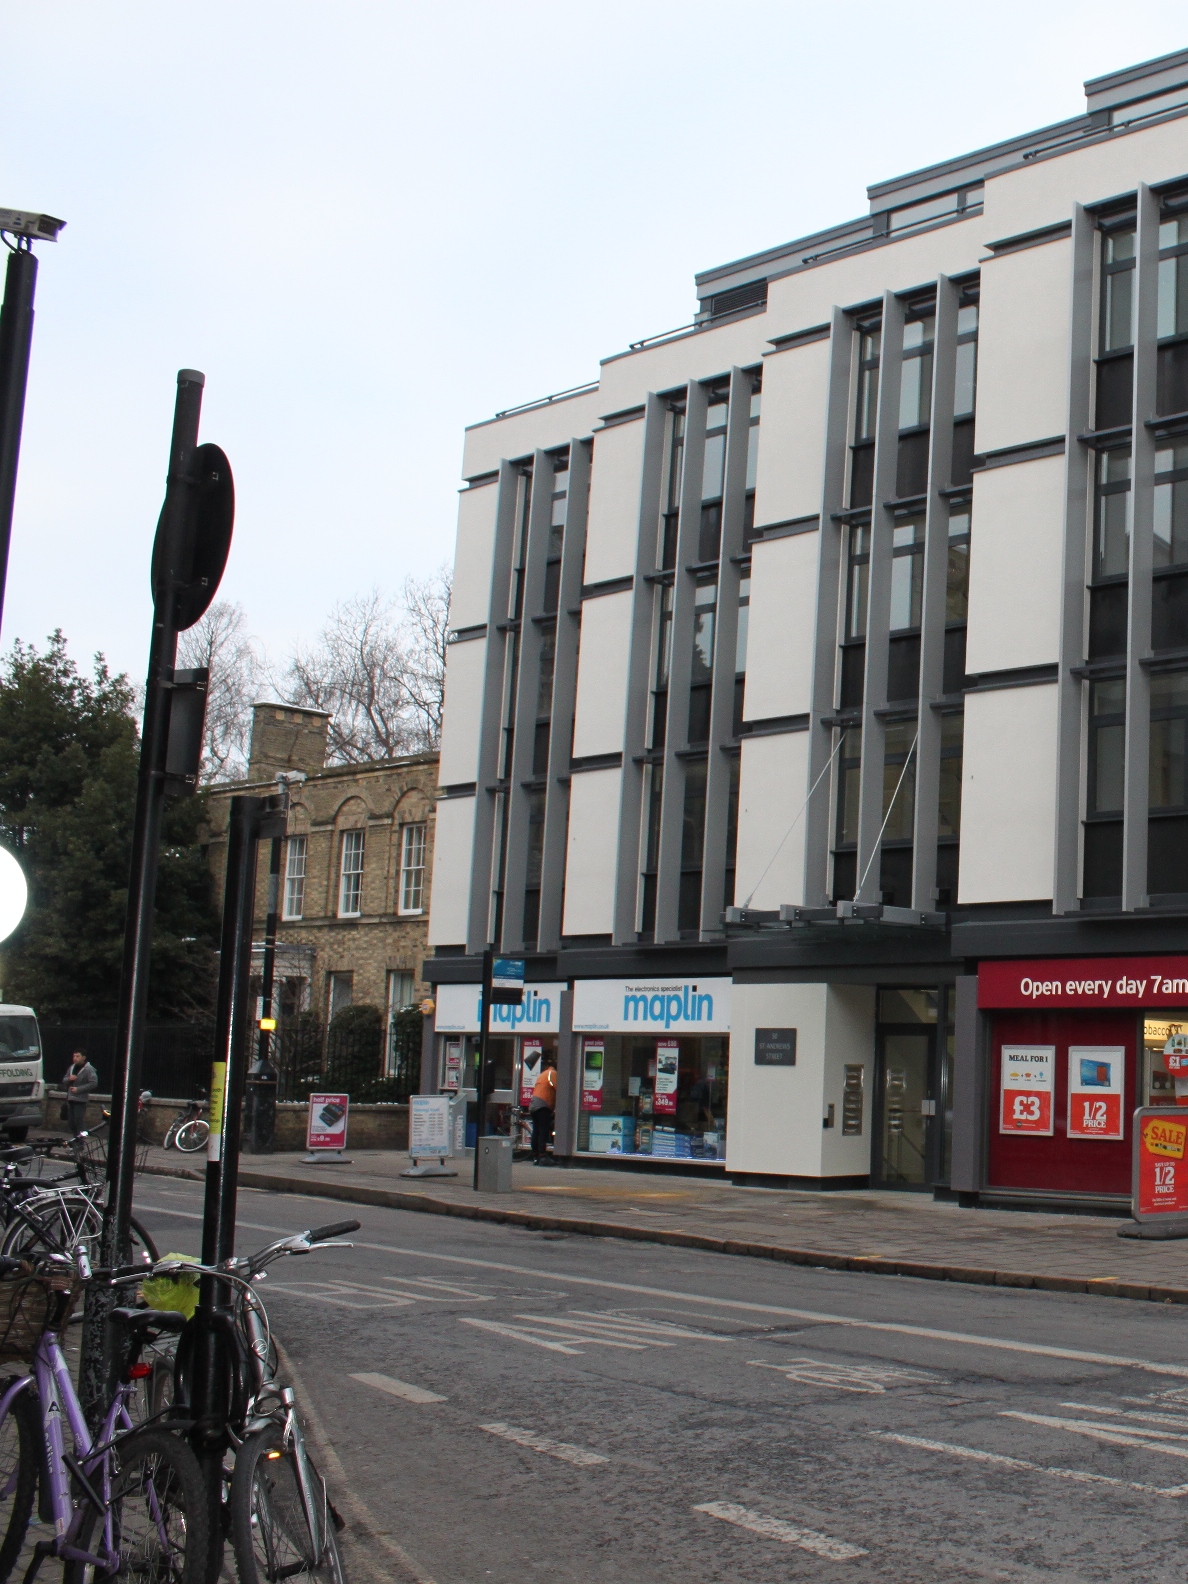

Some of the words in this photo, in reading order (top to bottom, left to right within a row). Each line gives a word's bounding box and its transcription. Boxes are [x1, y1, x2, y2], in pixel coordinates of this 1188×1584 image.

[1020, 977, 1062, 999] Open
[1065, 979, 1112, 998] every
[1115, 975, 1147, 998] day
[1150, 975, 1188, 993] 7am
[623, 985, 713, 1029] maplin
[1030, 1055, 1045, 1063] FOR
[1012, 1096, 1041, 1121] £3
[1083, 1101, 1107, 1120] 1/2
[1083, 1119, 1107, 1128] PRICE
[1150, 1126, 1184, 1146] SALE
[1154, 1166, 1175, 1185] 1/2
[1155, 1185, 1175, 1193] PRICE
[252, 1275, 568, 1309] BUS
